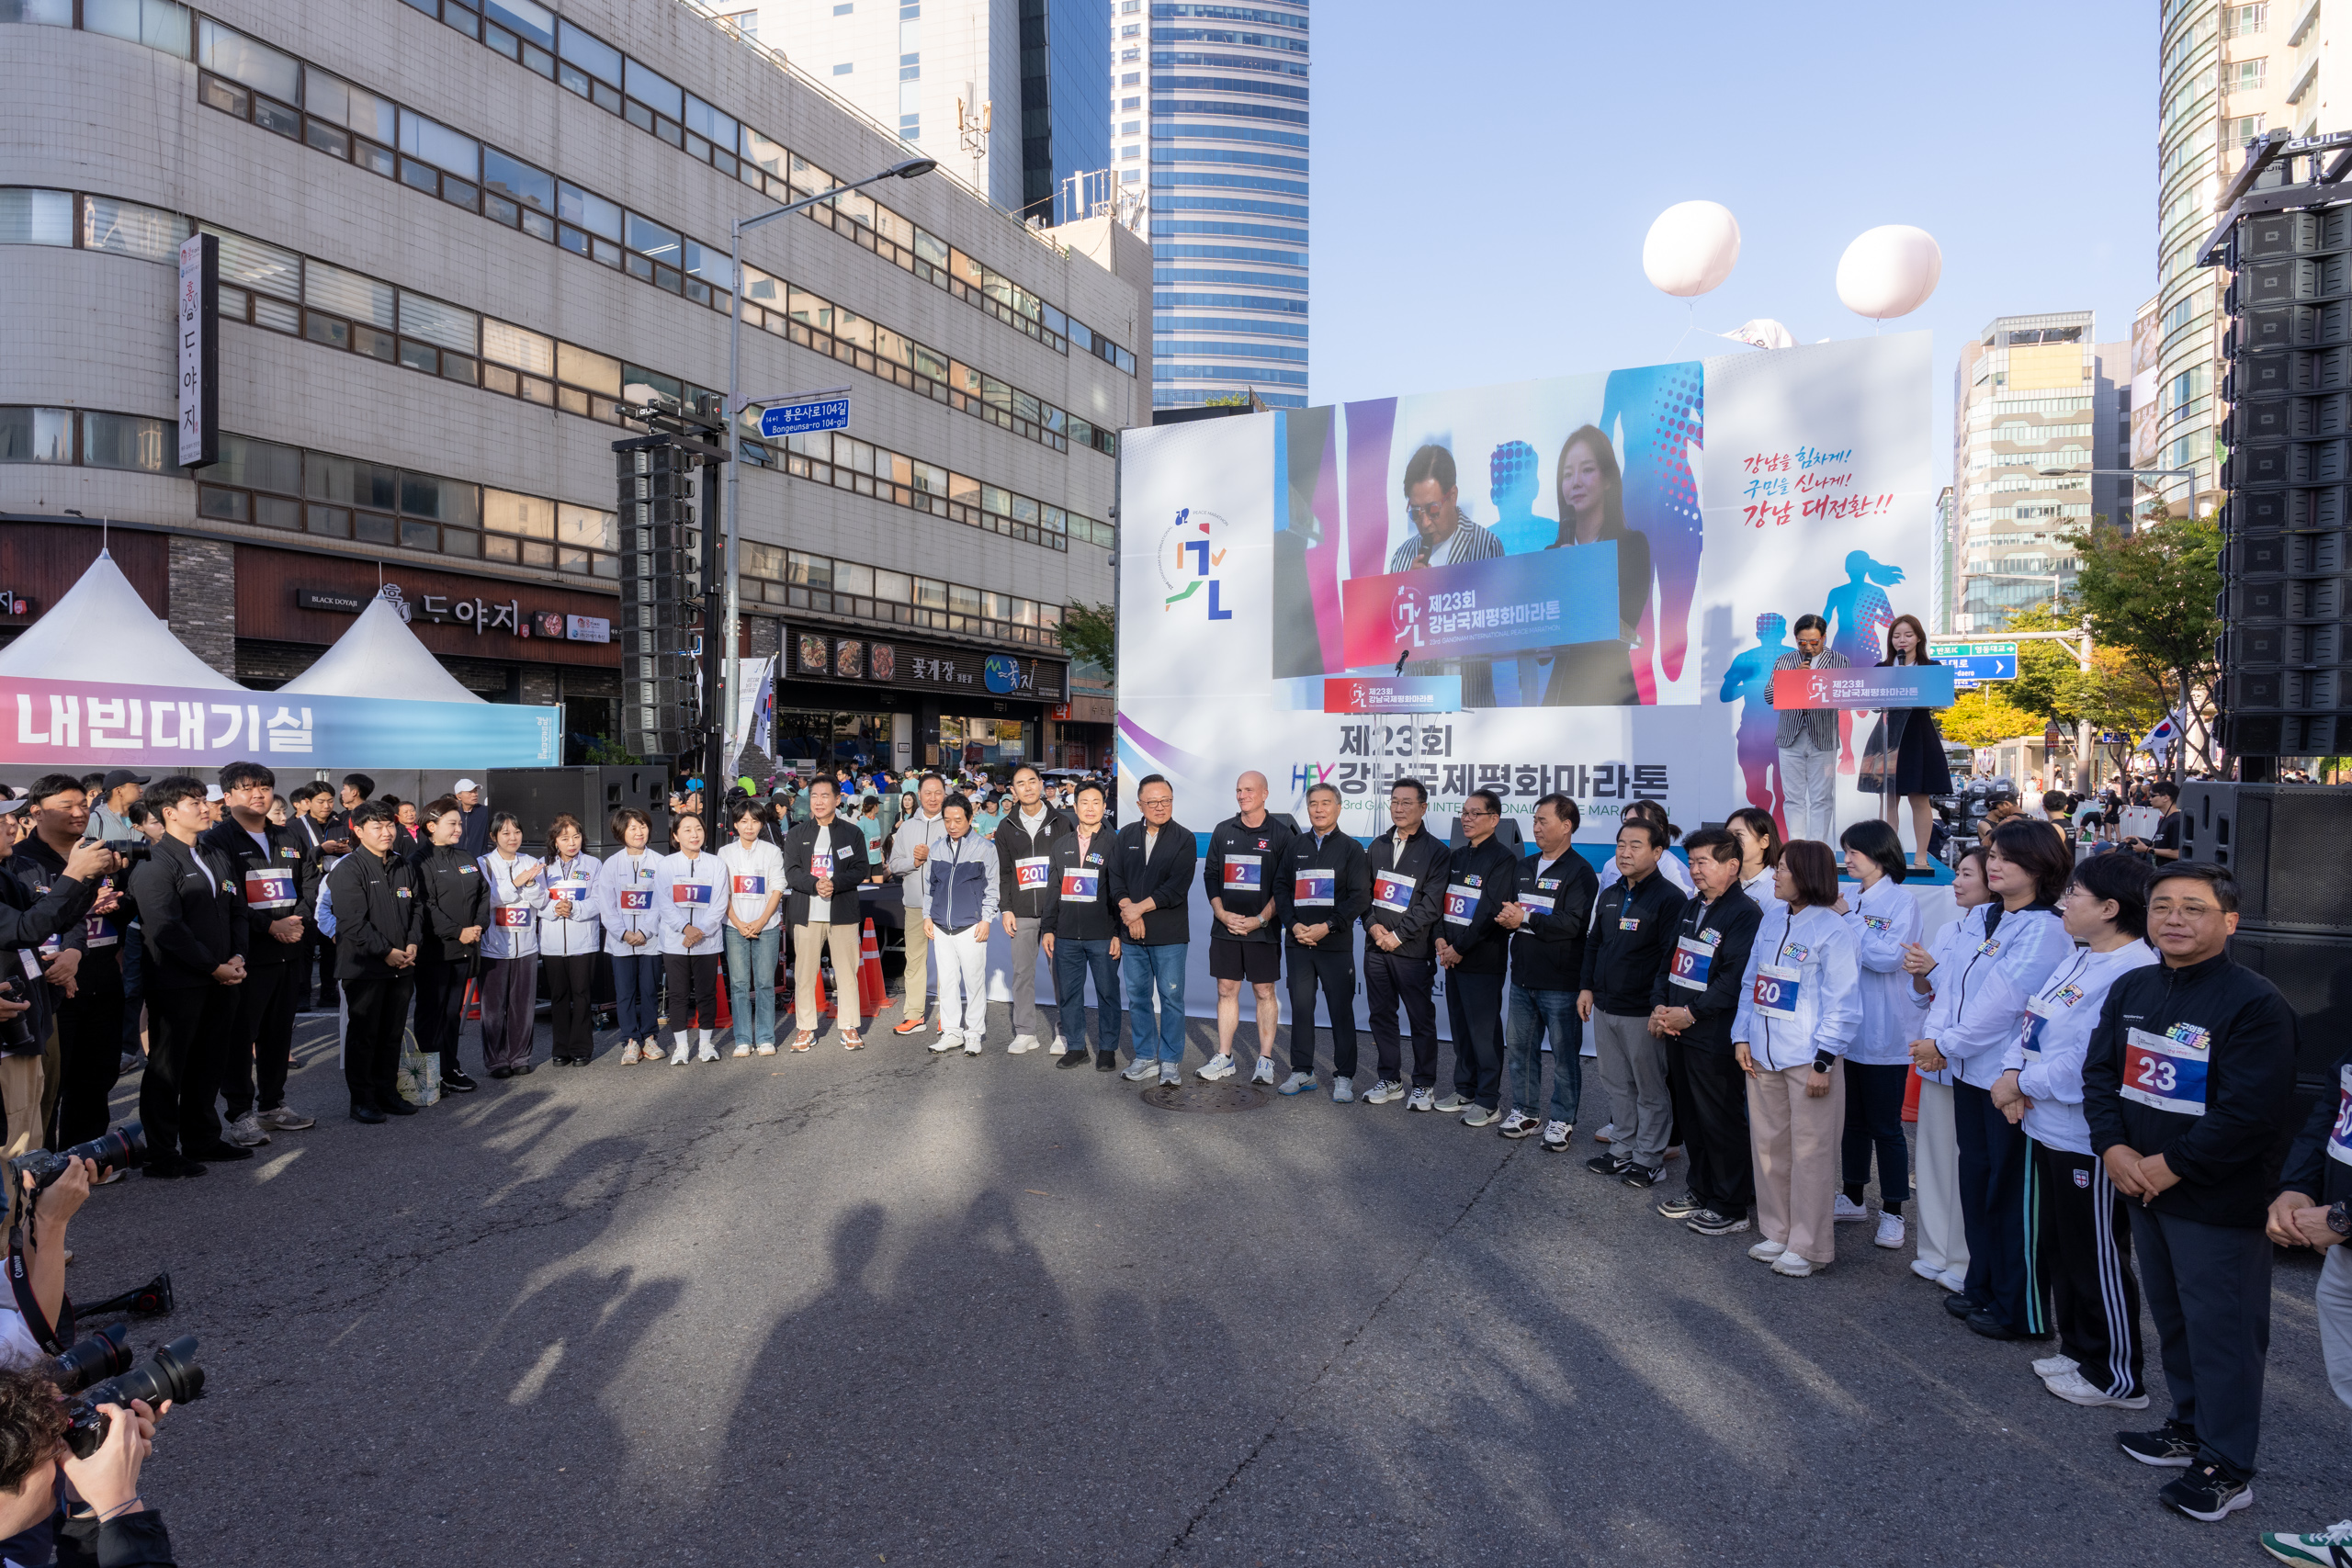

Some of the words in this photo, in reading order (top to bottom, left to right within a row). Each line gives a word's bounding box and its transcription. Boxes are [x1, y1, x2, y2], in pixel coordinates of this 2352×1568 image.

[2288, 132, 2349, 150] GUIL
[784, 401, 847, 423] 봉은사로104길
[772, 419, 820, 434] Bongeunsa-ro
[822, 416, 846, 428] 104-gil
[1744, 453, 1792, 474] 강남을
[1795, 446, 1852, 469] 힘차게!
[1743, 477, 1790, 500] 구민을
[1794, 472, 1852, 493] 신나게!
[1743, 500, 1795, 528] 강남
[1802, 493, 1894, 521] 대전환!!
[1207, 511, 1229, 526] MARATHON
[311, 596, 334, 604] BLACK
[334, 598, 357, 607] DOYAJI
[1428, 590, 1476, 614] 제23회
[1429, 600, 1561, 635] 강남국제평화마라톤
[1442, 636, 1469, 644] GANGNAM
[1469, 630, 1510, 641] INTERNATIONAL
[1510, 627, 1529, 637] PEACE
[1529, 624, 1561, 635] MARATHON
[1936, 647, 1958, 655] 반포IC
[1974, 645, 2006, 654] 영동대교
[911, 658, 956, 682] 꽃게장
[1368, 687, 1393, 695] 제23회
[1833, 680, 1864, 689] 제23회
[1368, 694, 1434, 704] 강남국제평화마라톤
[1832, 687, 1918, 698] 강남국제평화마라톤
[1055, 704, 1068, 719] 약
[17, 694, 313, 753] 내빈대기실
[1340, 725, 1453, 757] 제23회
[1339, 762, 1669, 800] 강남국제평화마라톤
[813, 856, 831, 869] 40
[1021, 867, 1045, 882] 201
[1236, 866, 1245, 880] 2
[263, 881, 285, 898] 31
[743, 879, 753, 891] 9
[1073, 879, 1083, 893] 6
[1309, 882, 1316, 896] 1
[1384, 885, 1396, 899] 8
[557, 890, 576, 901] 35
[628, 893, 647, 907] 34
[684, 886, 698, 900] 11
[1450, 897, 1465, 914] 18
[506, 910, 526, 924] 32
[86, 917, 103, 936] 27
[1677, 953, 1694, 975] 19
[1757, 979, 1781, 1003] 20
[2179, 1021, 2207, 1035] 구의원
[2137, 1055, 2177, 1091] 23
[13, 1255, 24, 1279] Canon
